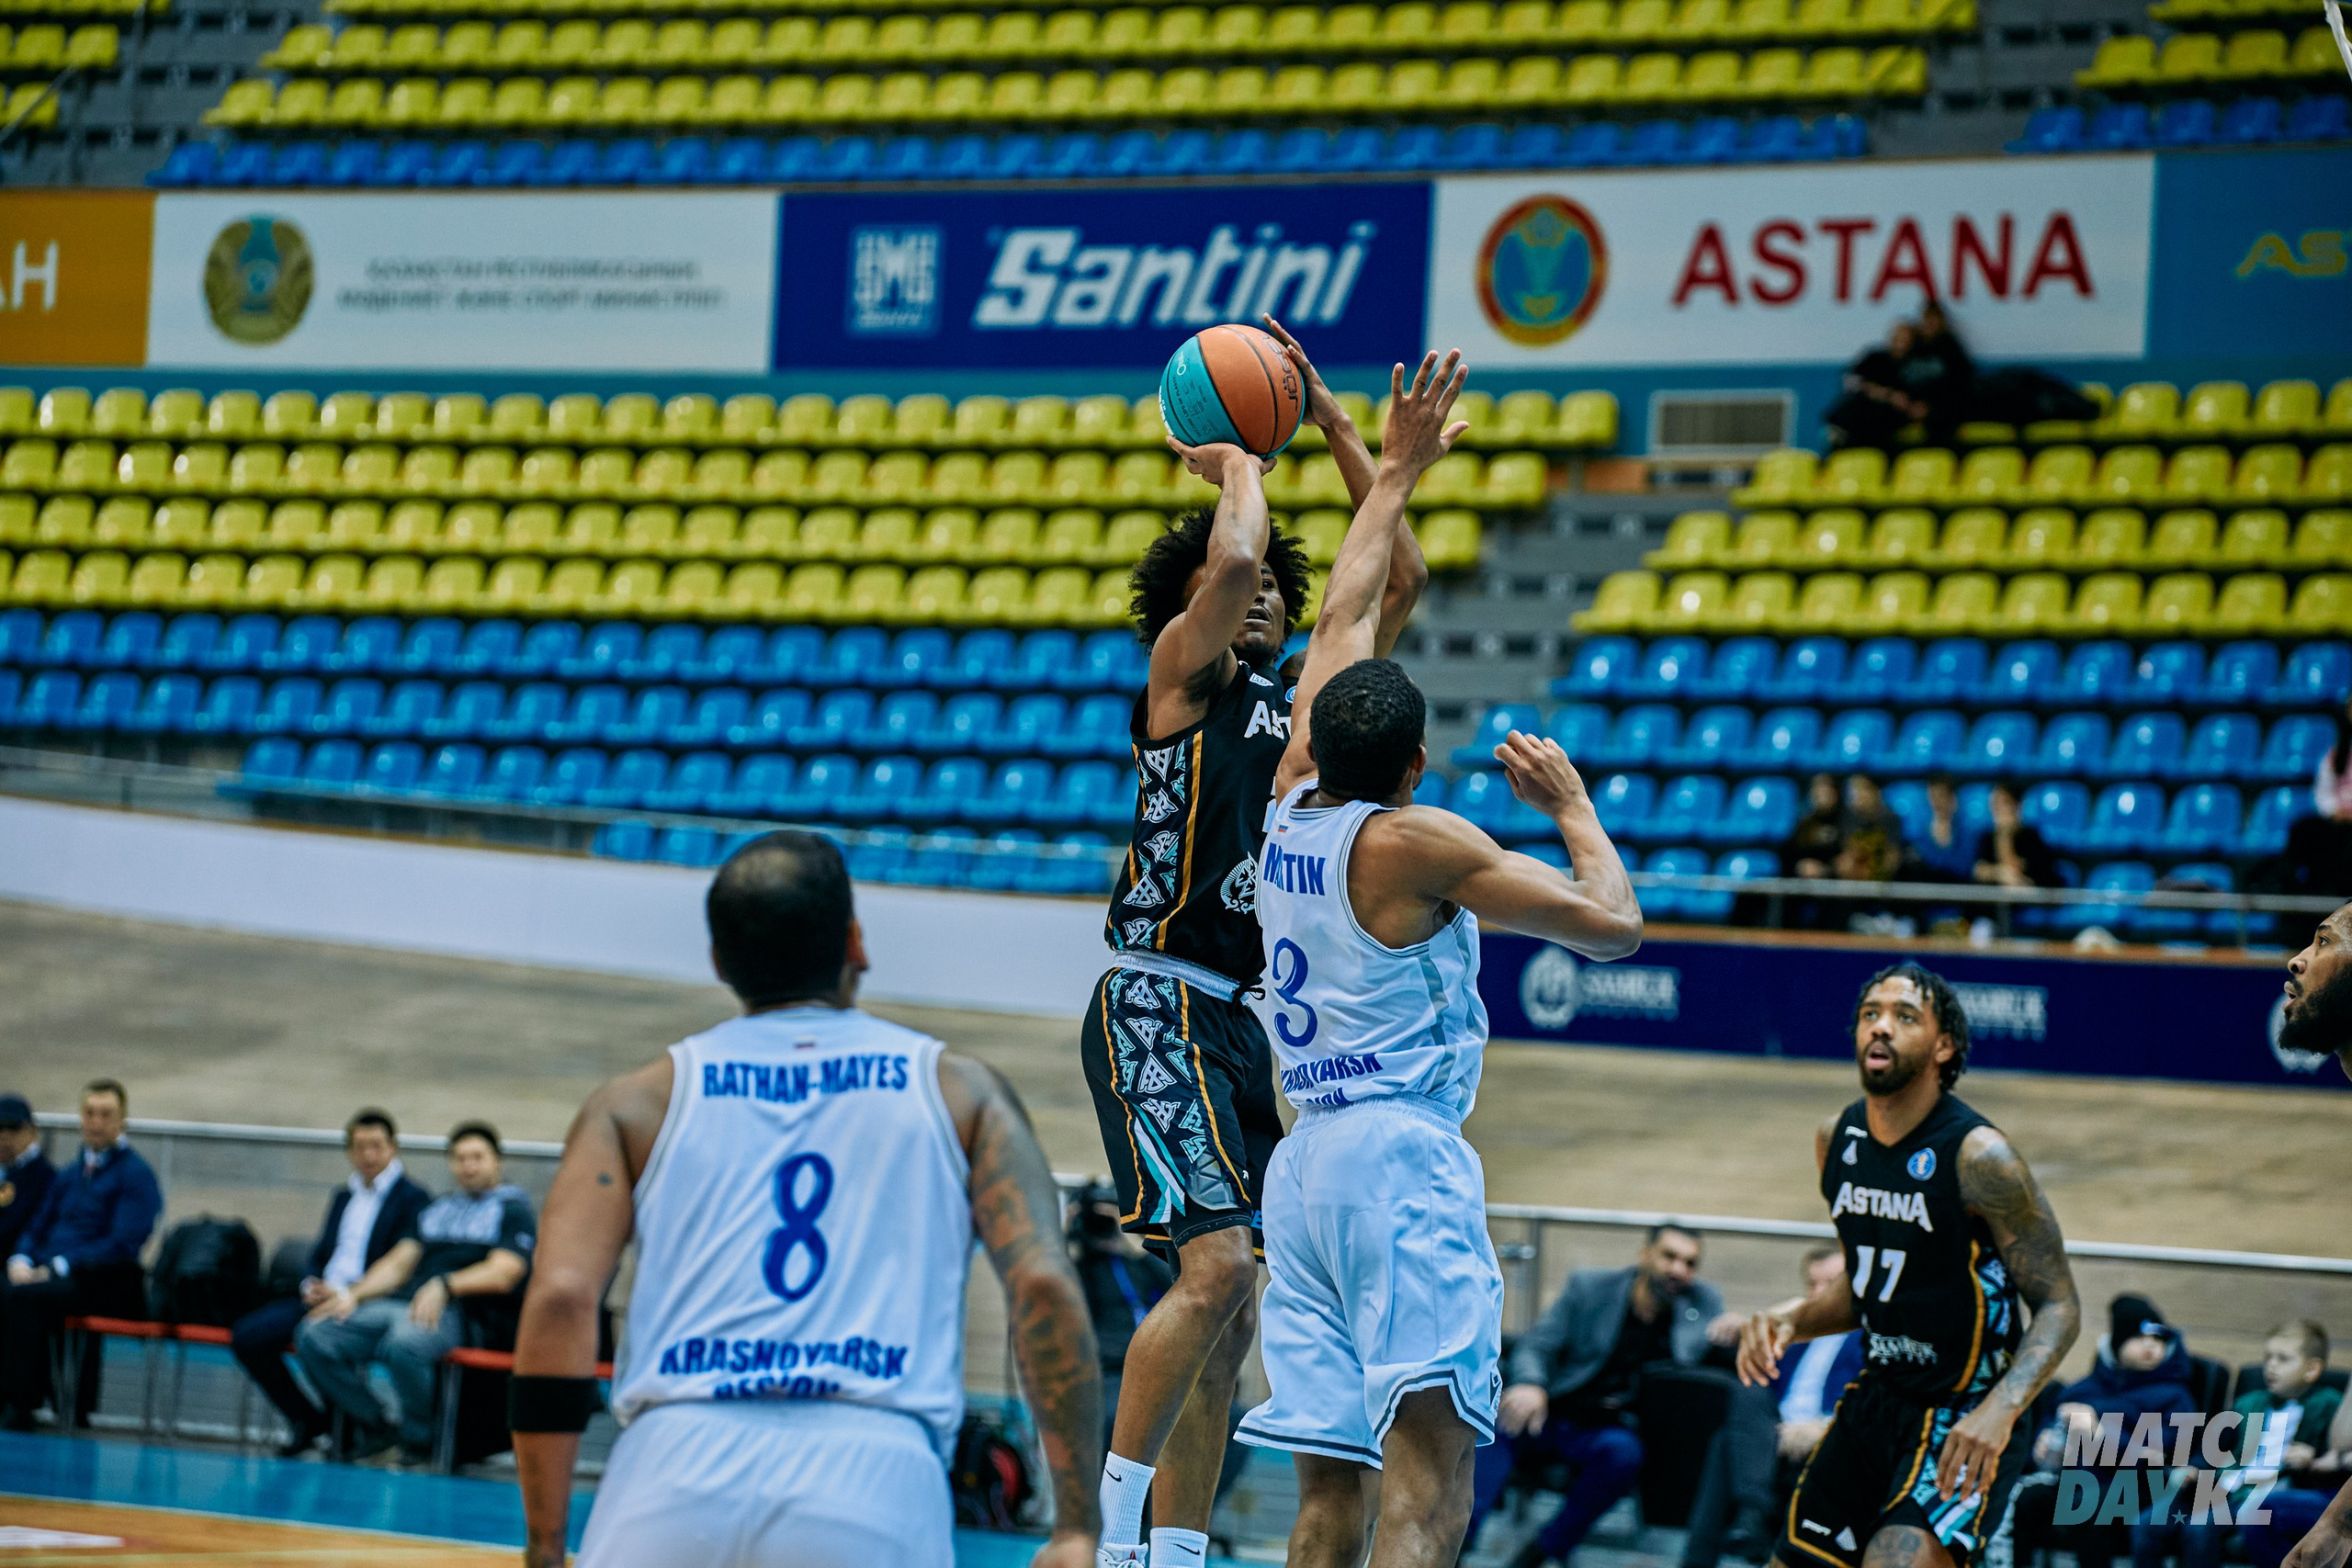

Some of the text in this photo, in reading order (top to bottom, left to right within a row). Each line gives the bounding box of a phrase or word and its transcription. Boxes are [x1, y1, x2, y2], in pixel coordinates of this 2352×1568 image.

[974, 221, 1376, 328] Santini
[1672, 211, 2093, 307] ASTANA
[1272, 937, 1318, 1047] 3
[704, 1054, 909, 1102] RATHAN-MAYES
[763, 1152, 834, 1303] 8
[1831, 1181, 1934, 1233] ASTANA
[1852, 1245, 1907, 1303] 17
